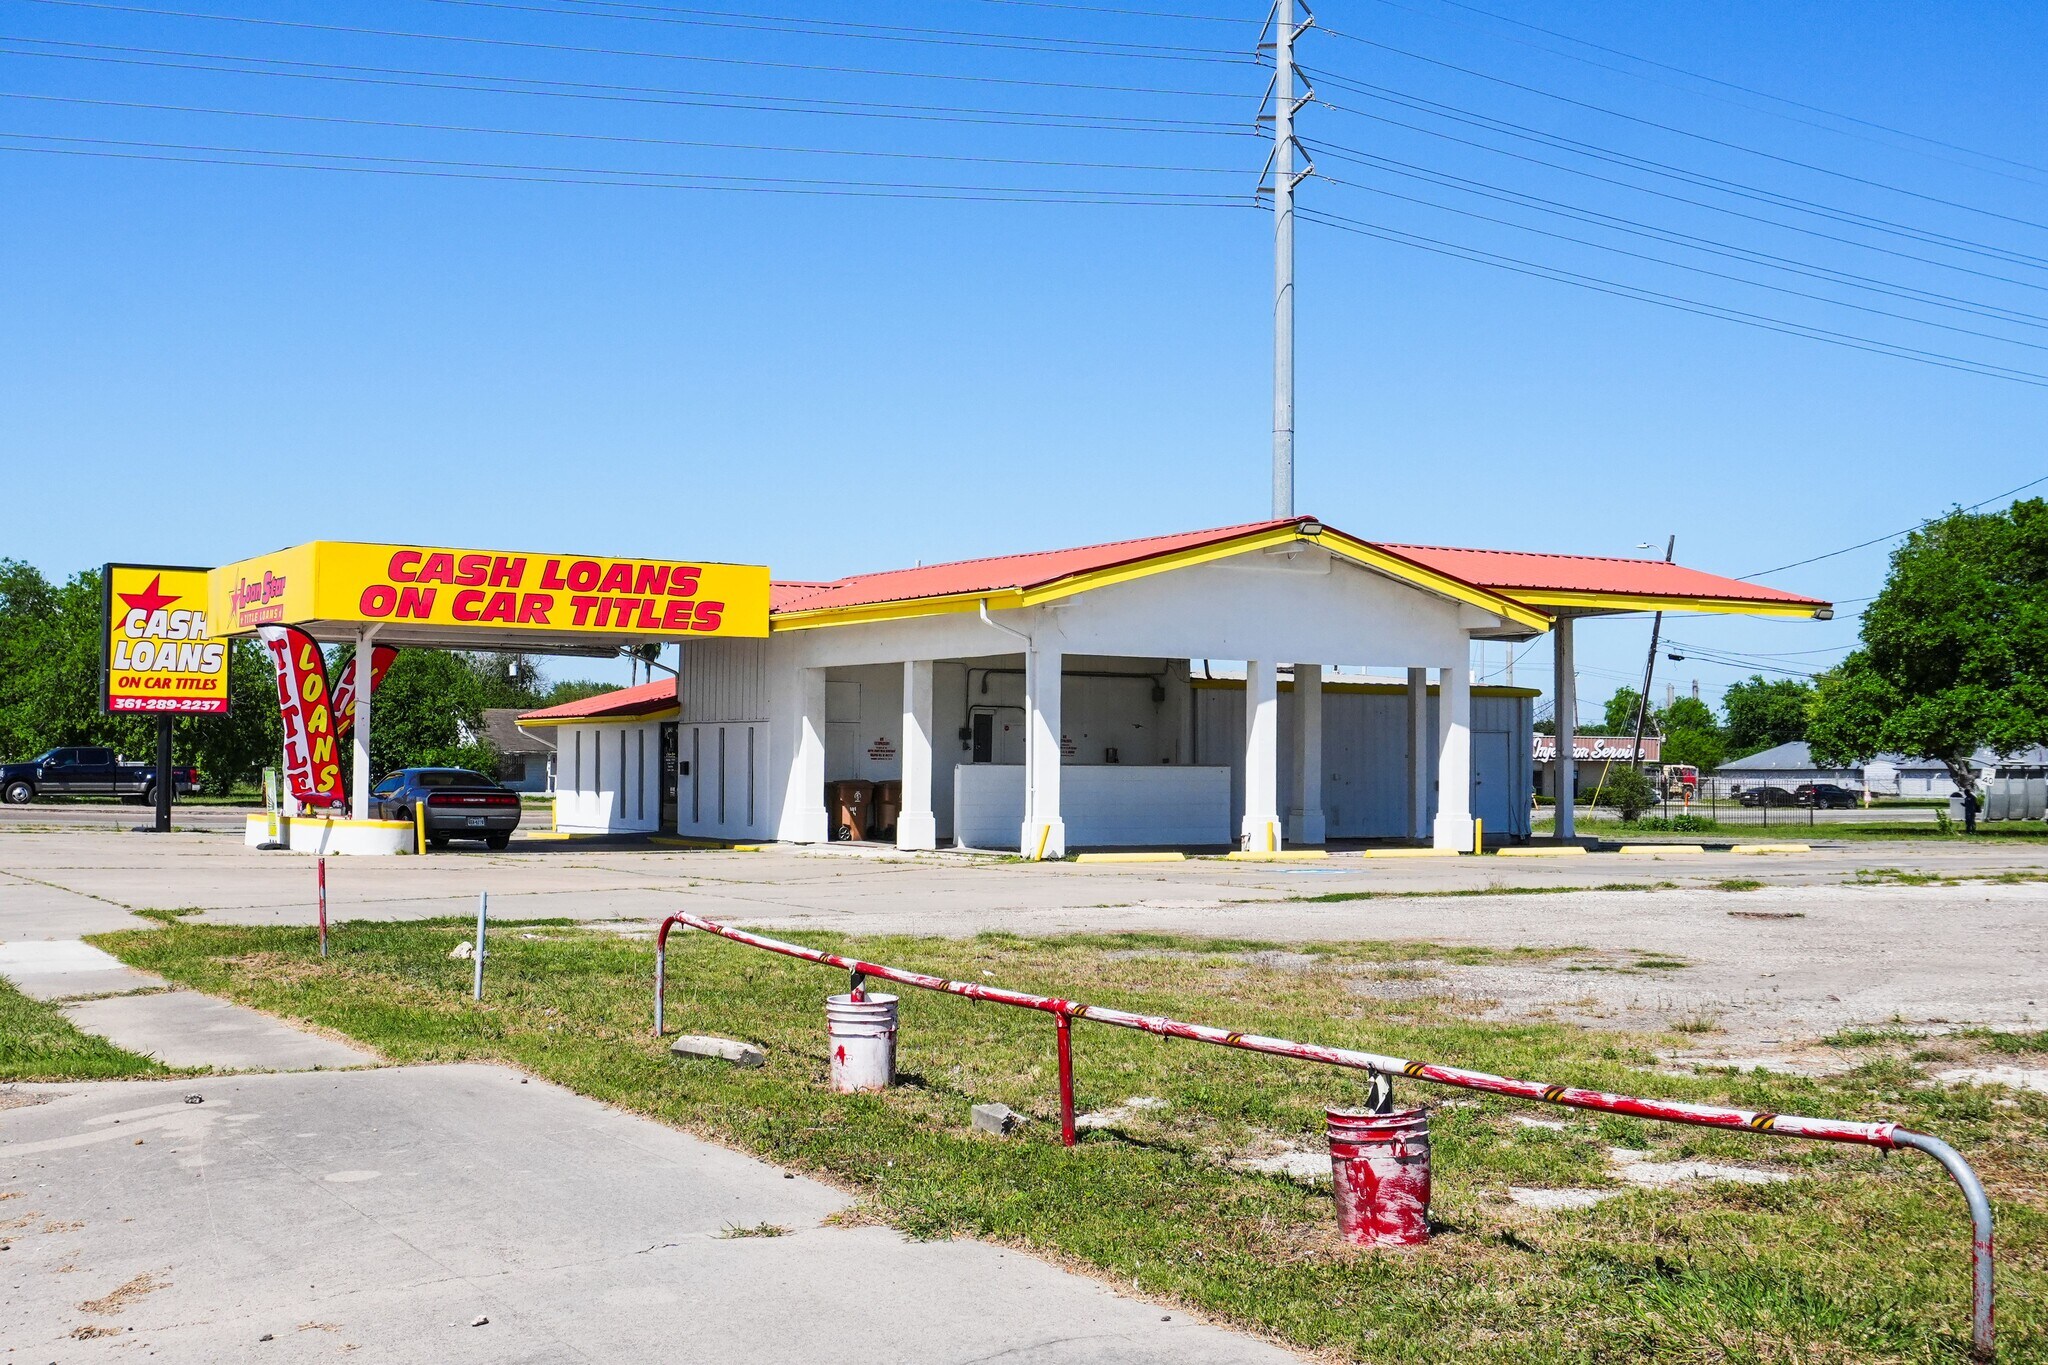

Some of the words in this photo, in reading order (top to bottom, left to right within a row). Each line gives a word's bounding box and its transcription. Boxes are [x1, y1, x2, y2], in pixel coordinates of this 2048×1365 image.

[239, 577, 262, 609] Loan
[262, 570, 286, 604] Star
[388, 550, 527, 588] CASH
[539, 559, 702, 597] LOANS
[124, 608, 209, 640] CASH
[244, 612, 259, 624] TITLE
[259, 608, 278, 622] LOANS
[359, 585, 438, 619] ON
[452, 589, 554, 624] CAR
[570, 595, 725, 631] TITLES
[112, 640, 225, 674] LOANS
[118, 676, 142, 689] ON
[144, 677, 172, 690] CAR
[176, 678, 218, 690] TITLES
[114, 698, 221, 711] 361-289-2237
[268, 638, 312, 794] TITLE
[298, 643, 339, 793] LOANS
[1533, 738, 1589, 763] Injeion
[1982, 777, 1994, 785] 40
